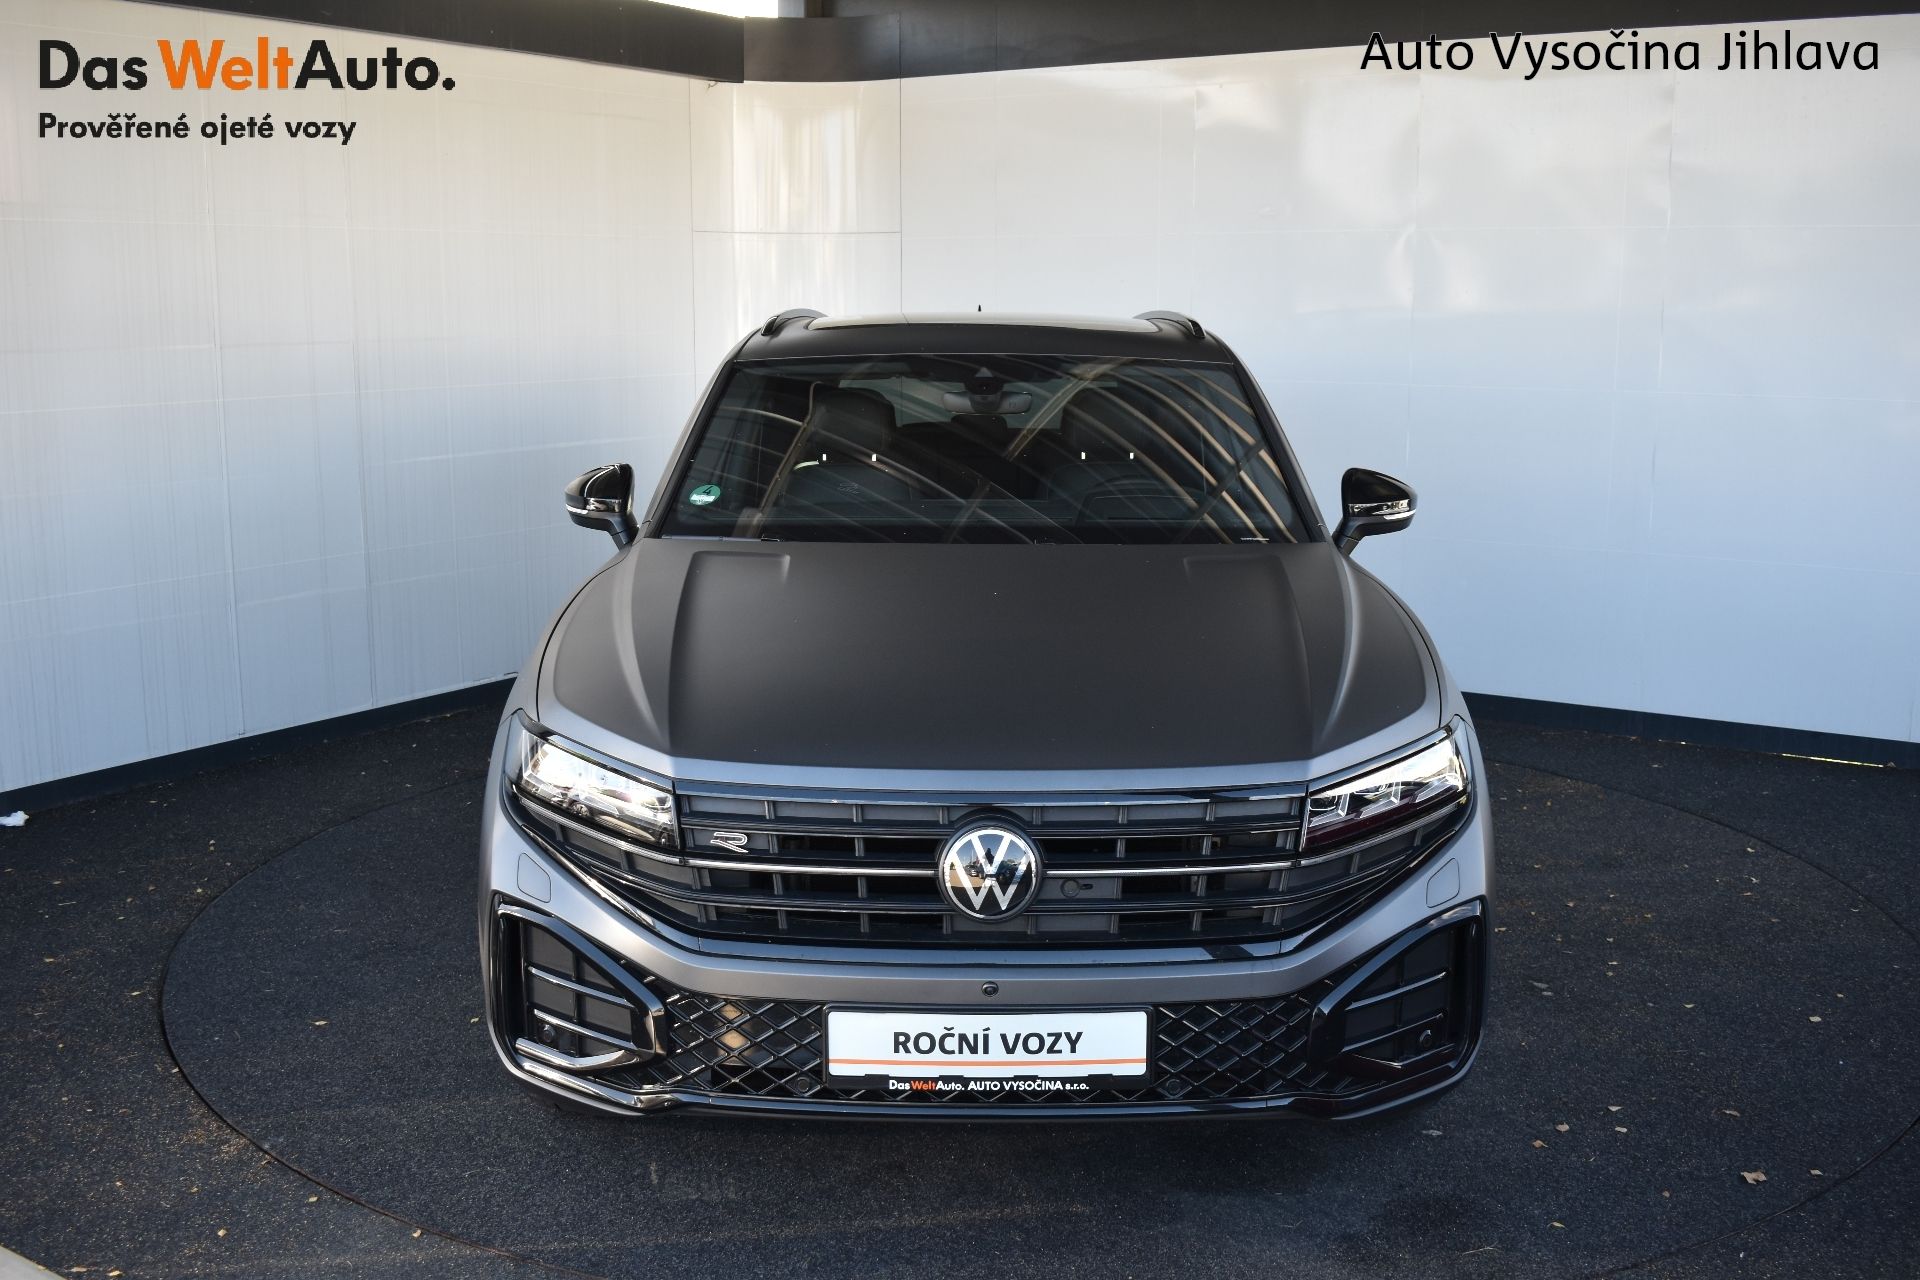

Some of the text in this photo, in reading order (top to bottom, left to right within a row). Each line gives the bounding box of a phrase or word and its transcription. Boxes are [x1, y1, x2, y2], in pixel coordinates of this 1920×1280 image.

[703, 486, 713, 495] 4
[893, 1026, 1084, 1055] ROČNÍ VOZY
[968, 1080, 1000, 1091] AUTO
[1002, 1079, 1063, 1092] VYSOČINA
[1065, 1082, 1090, 1091] s.r.o.
